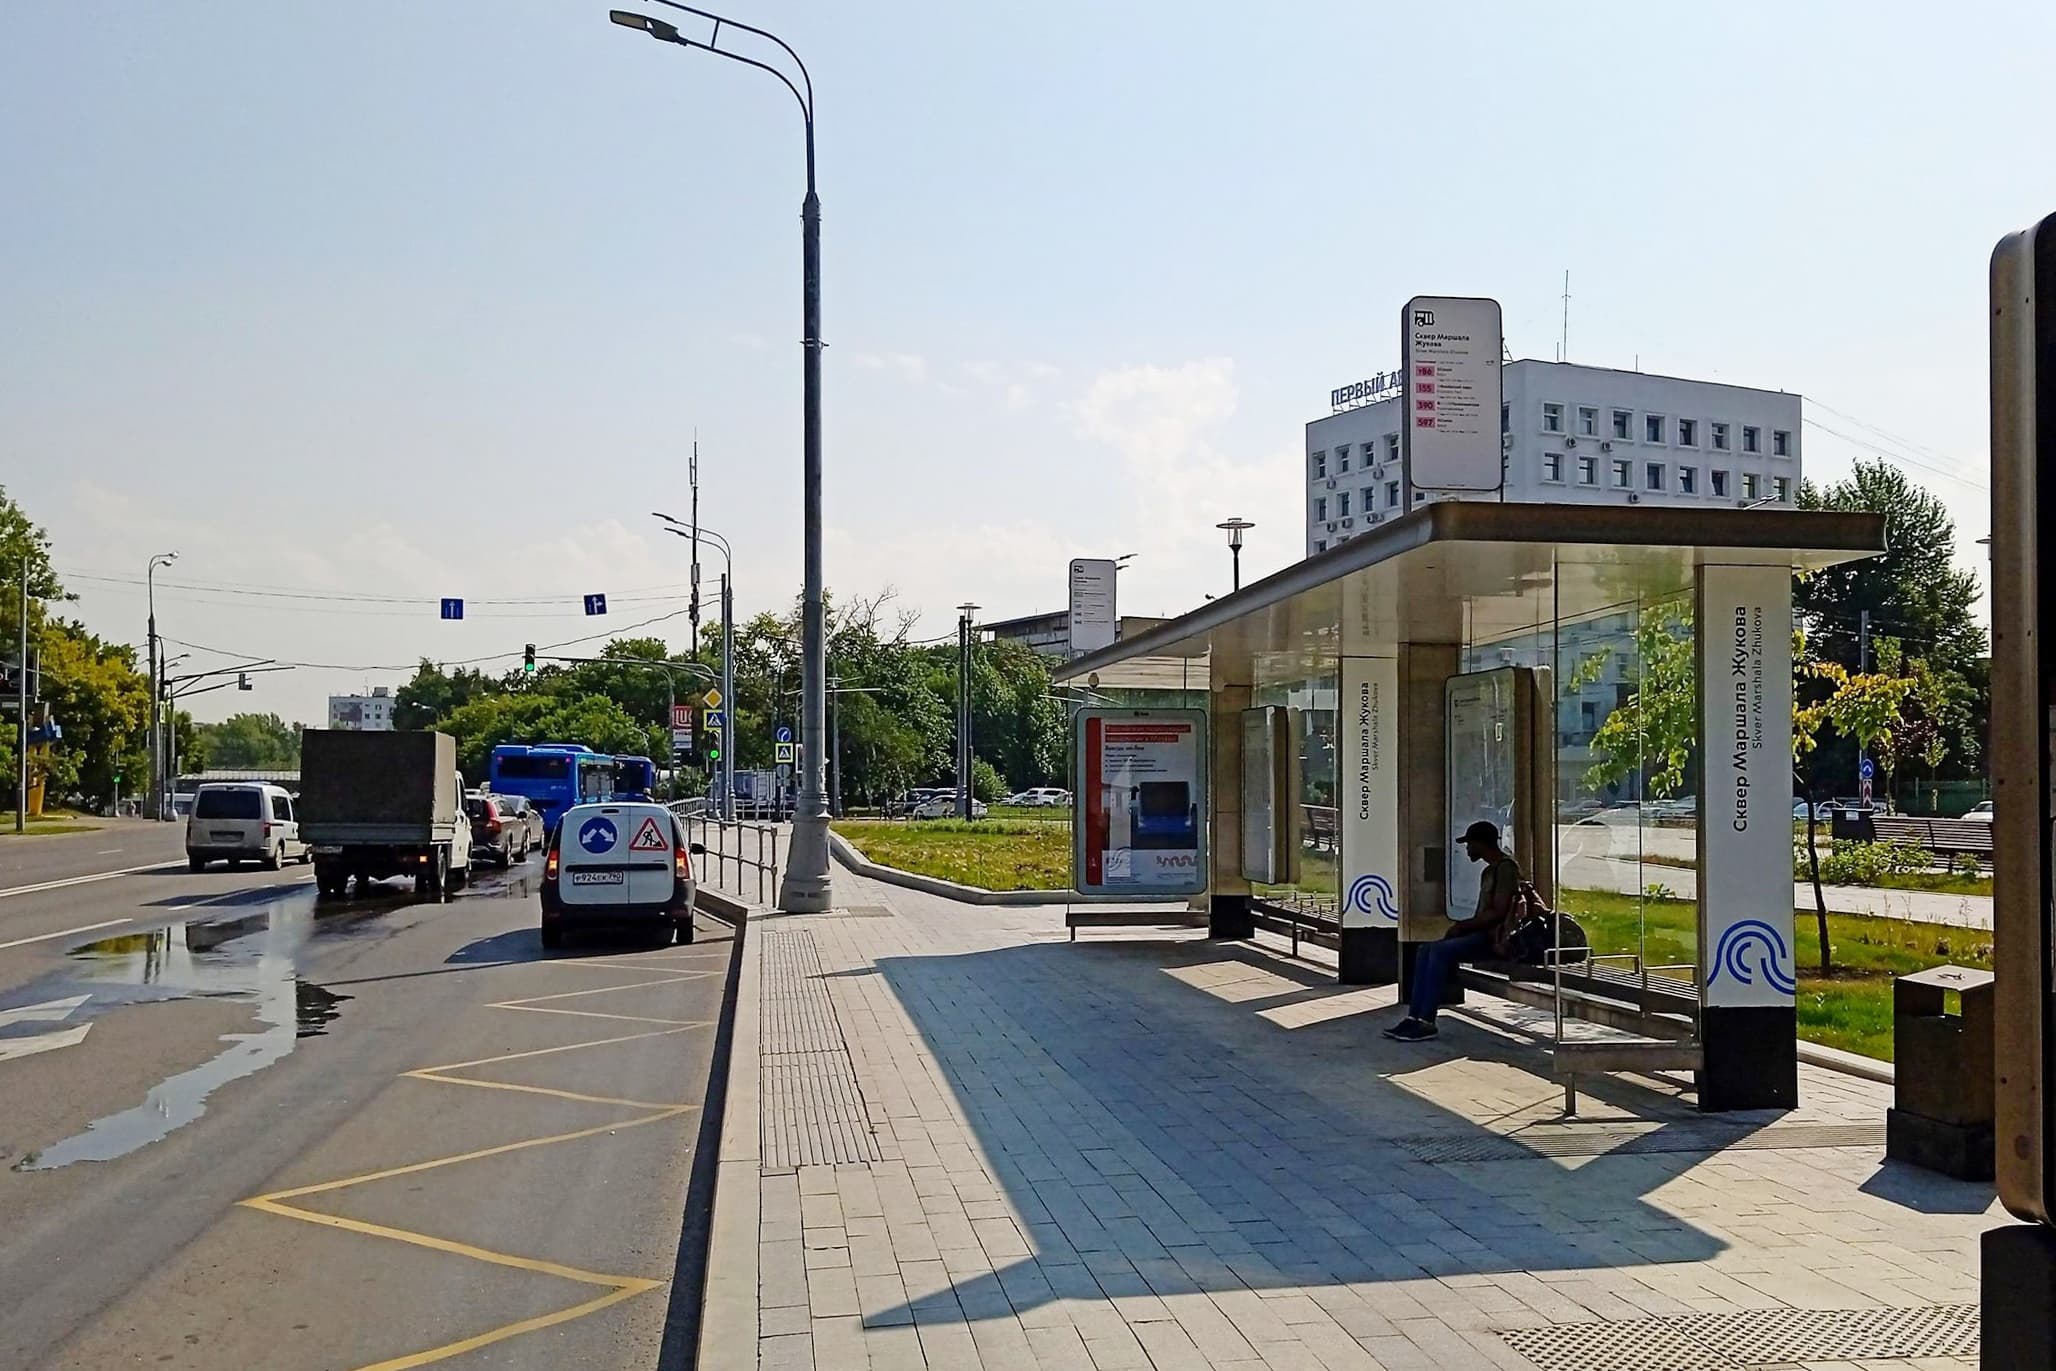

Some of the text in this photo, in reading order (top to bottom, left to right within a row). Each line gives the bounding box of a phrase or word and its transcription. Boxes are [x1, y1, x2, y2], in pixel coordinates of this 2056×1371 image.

[1415, 332, 1470, 341] Сквер Маршала
[1415, 340, 1442, 348] Жукова
[1331, 371, 1386, 407] ПЕРВЫЙ
[1418, 418, 1434, 428] 597
[1752, 606, 1762, 749] Skver Marshala Zhukova
[1732, 606, 1750, 832] Сквер Маршала Жукова
[1360, 682, 1371, 820] Сквер Маршала Жукова
